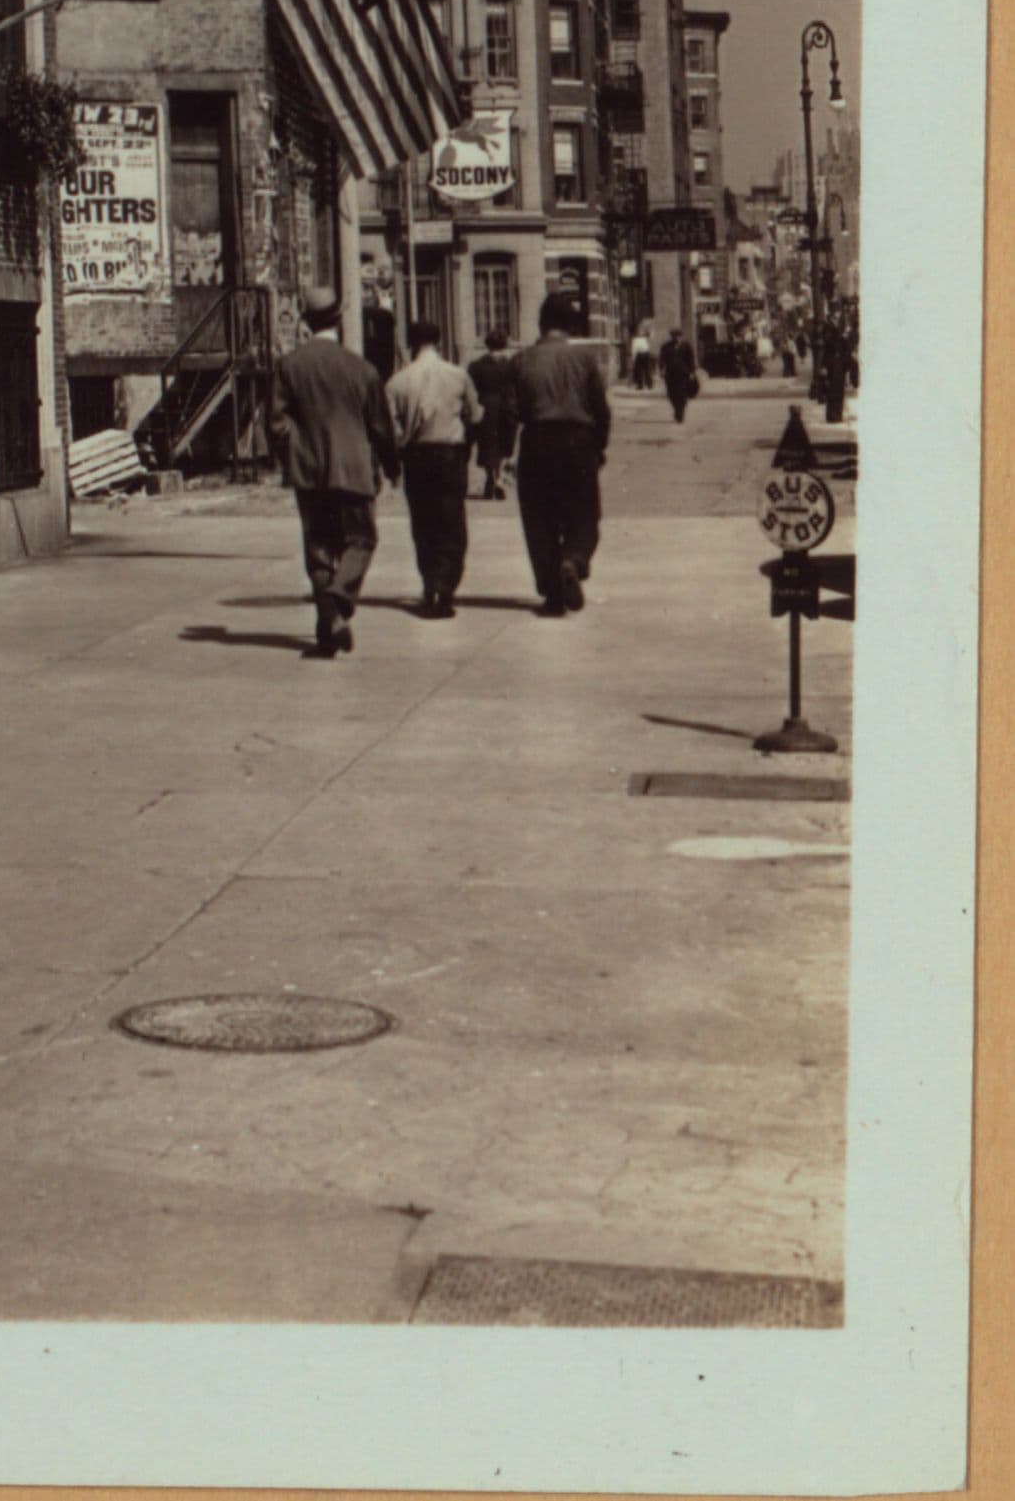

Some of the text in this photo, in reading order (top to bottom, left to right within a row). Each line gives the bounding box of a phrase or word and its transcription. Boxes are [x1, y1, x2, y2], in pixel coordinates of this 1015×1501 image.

[435, 166, 509, 186] SOCONY
[62, 198, 157, 224] GHTERS
[765, 475, 824, 504] BUS
[762, 512, 825, 542] STOP
